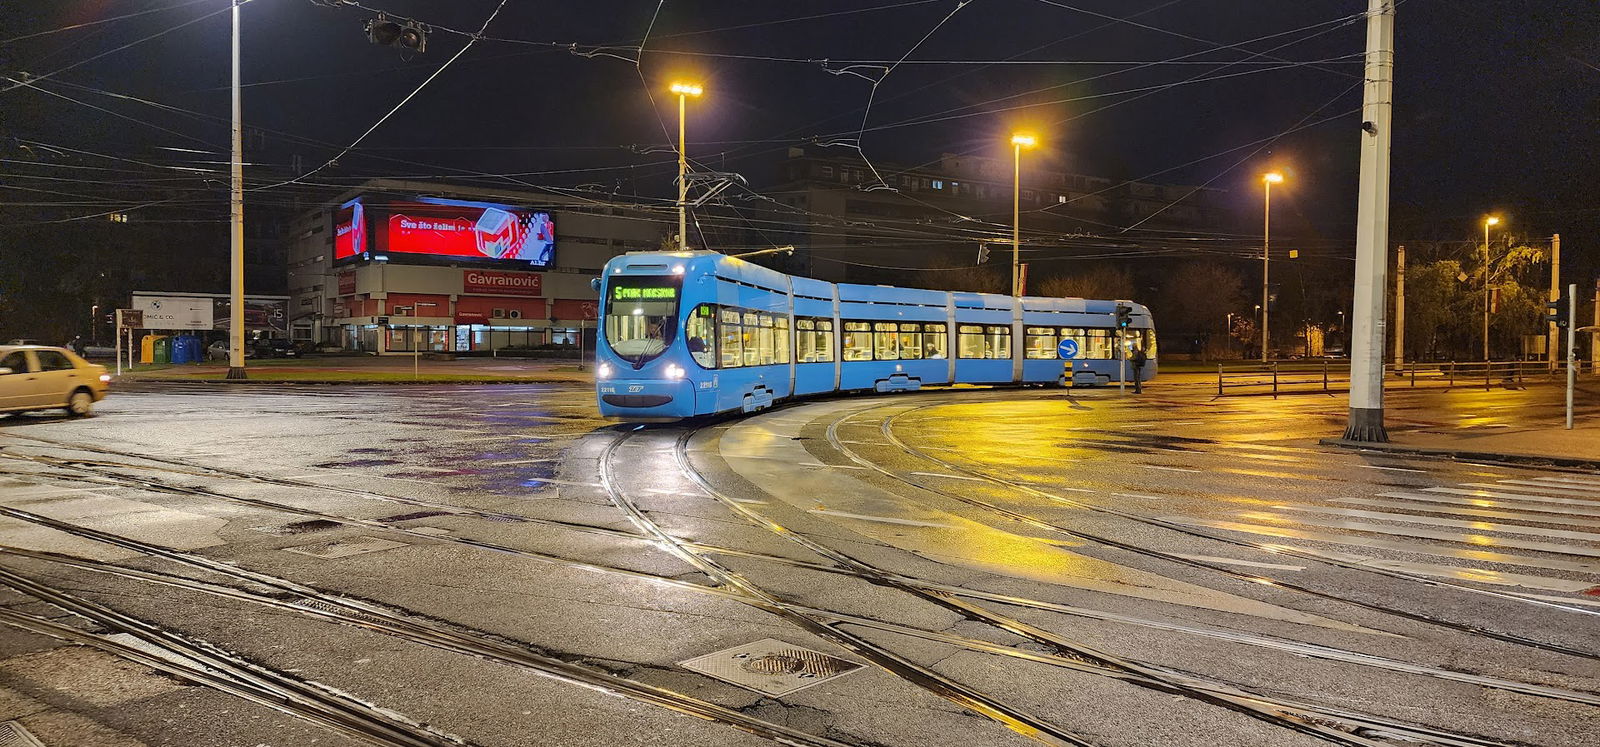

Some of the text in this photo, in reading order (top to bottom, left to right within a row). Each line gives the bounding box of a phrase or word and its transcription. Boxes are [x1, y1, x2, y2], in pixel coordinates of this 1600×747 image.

[401, 220, 417, 229] Sve
[468, 274, 539, 287] Gavranović
[616, 287, 622, 299] 5
